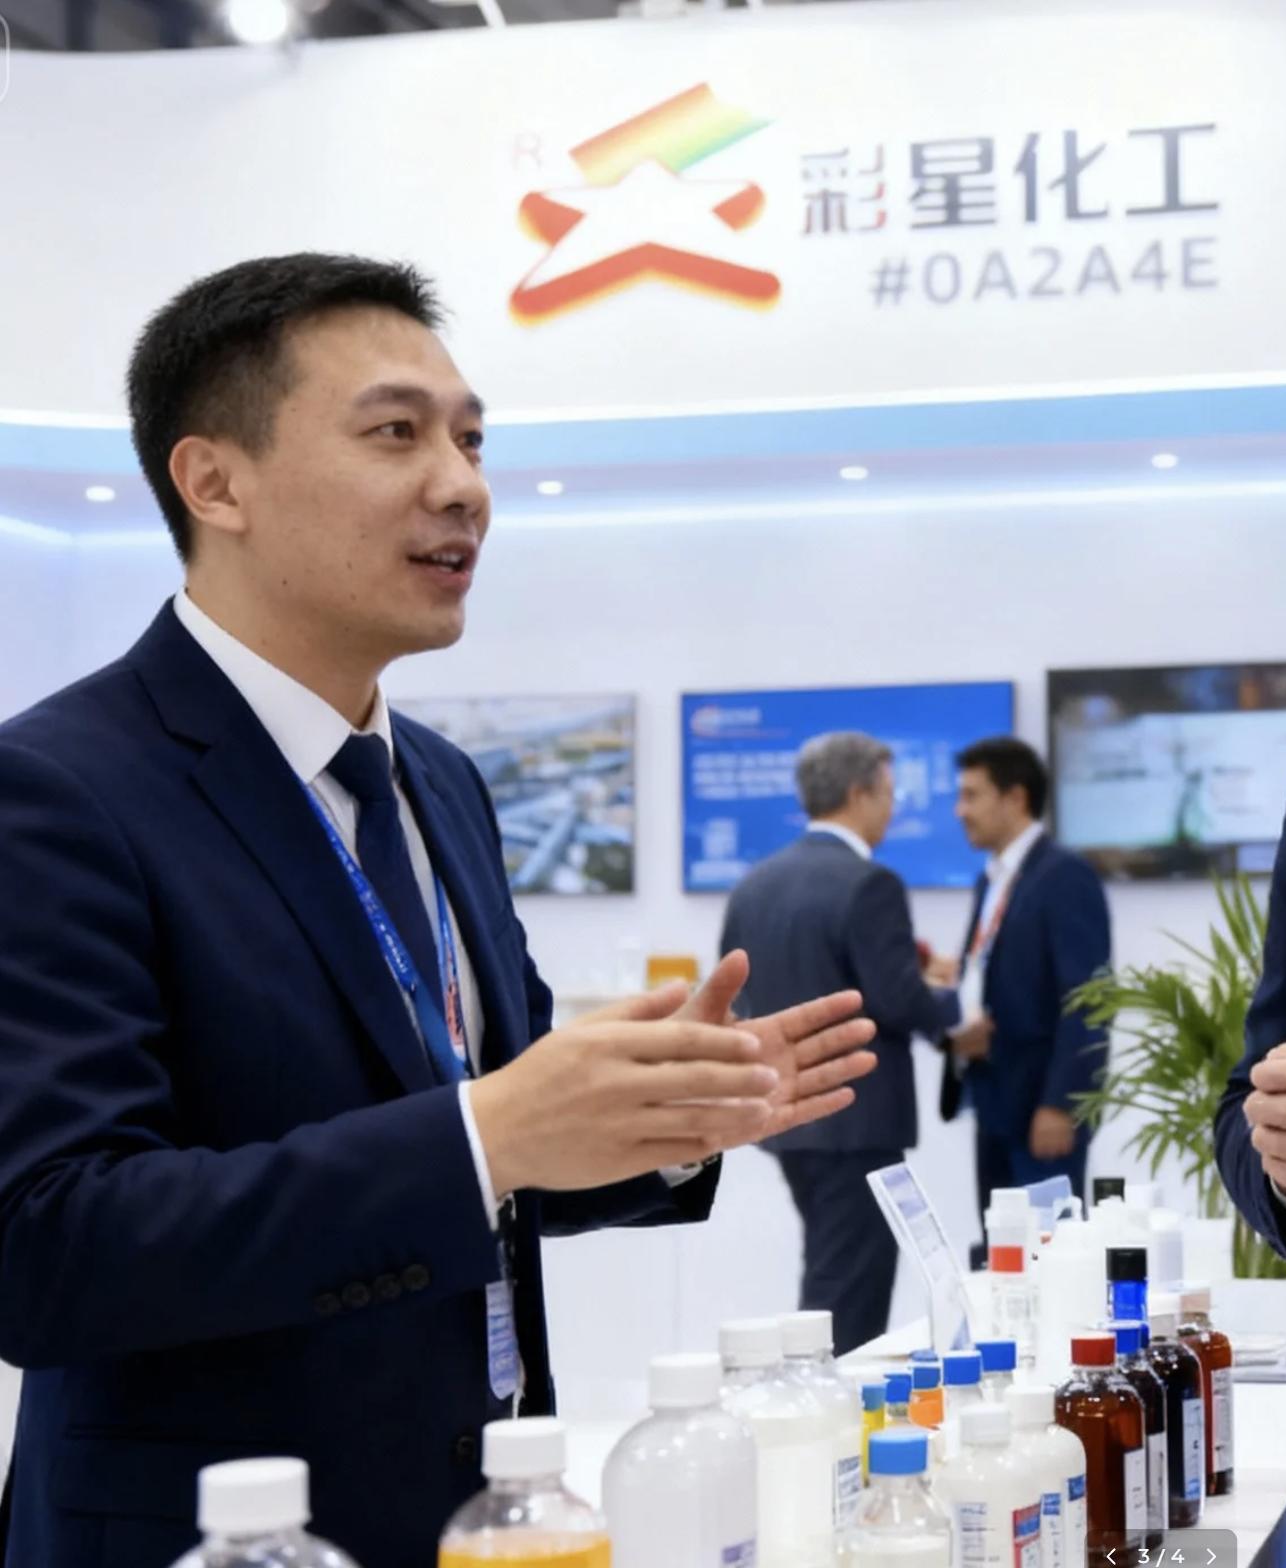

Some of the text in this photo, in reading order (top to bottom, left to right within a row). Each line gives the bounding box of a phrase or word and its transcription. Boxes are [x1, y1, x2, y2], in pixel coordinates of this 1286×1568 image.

[801, 123, 1220, 236] 彩星化工
[869, 238, 1219, 307] #0A2A4E
